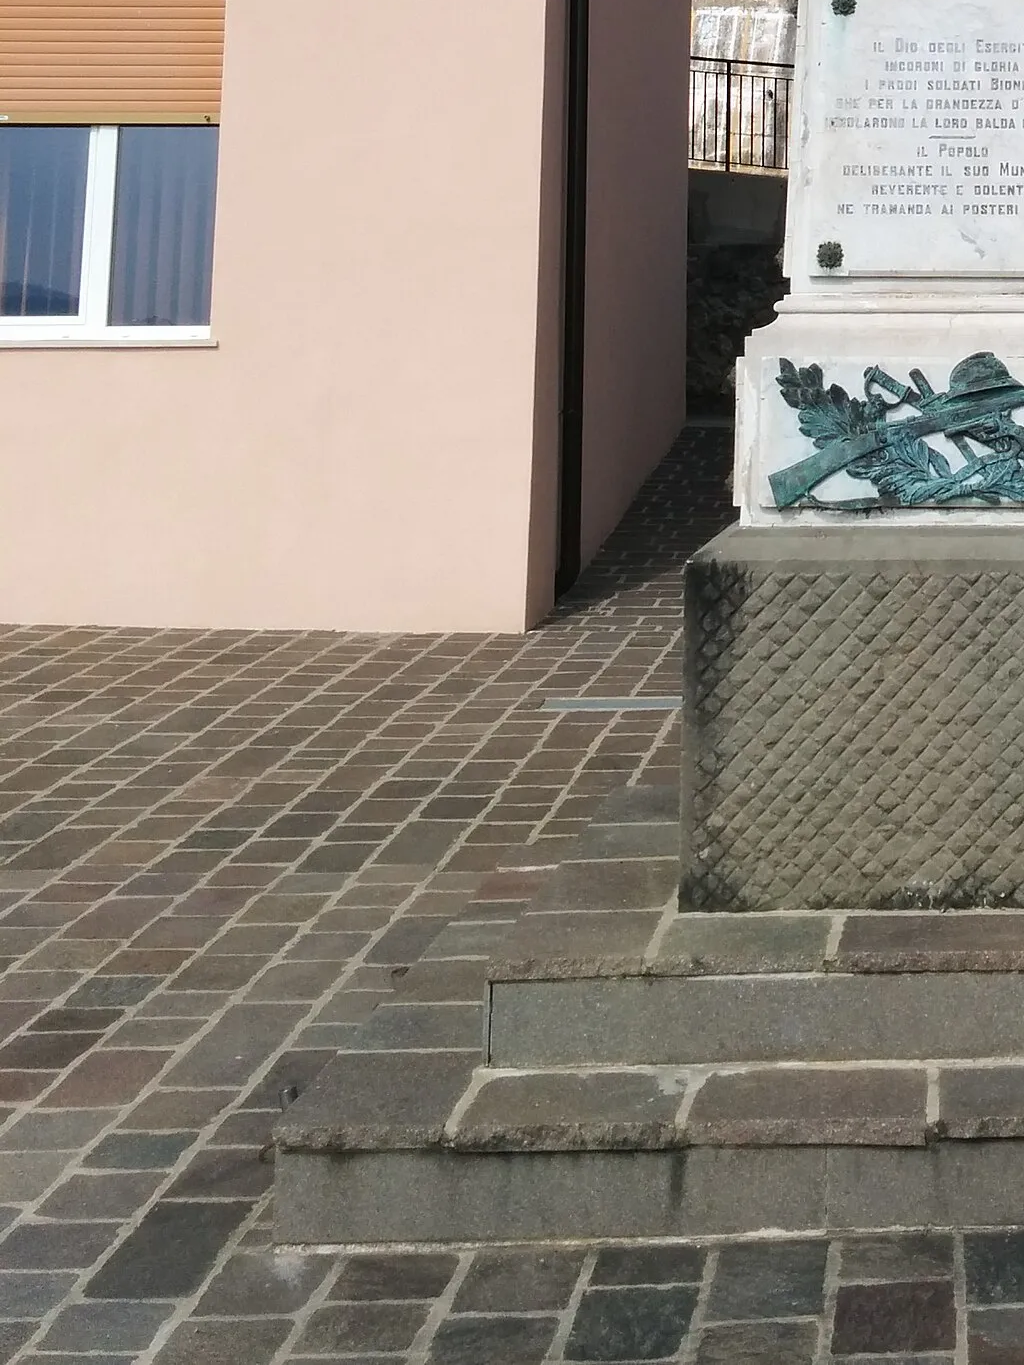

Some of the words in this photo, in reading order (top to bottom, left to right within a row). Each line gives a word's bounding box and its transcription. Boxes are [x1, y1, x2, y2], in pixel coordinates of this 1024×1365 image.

[873, 41, 885, 53] IL
[928, 42, 966, 53] DEGLI
[885, 61, 944, 72] INCORONI
[953, 61, 966, 72] DI
[974, 61, 1020, 72] GLORIA
[864, 79, 869, 91] I
[879, 79, 917, 91] PRODI
[927, 79, 981, 91] SOLDATI
[868, 98, 894, 110] PER
[902, 99, 918, 110] LA
[926, 99, 1003, 110] GRANDEZZA
[912, 117, 928, 129] LA
[935, 118, 968, 129] LORO
[976, 118, 1016, 130] BALDA
[916, 146, 929, 158] IL
[843, 165, 933, 176] DELIBERANTE
[941, 165, 953, 176] IL
[964, 165, 989, 177] SUO
[872, 184, 948, 196] REVERENTE
[956, 185, 964, 196] E
[837, 204, 854, 215] NE
[863, 204, 932, 215] TRAMANDA
[941, 204, 954, 215] AI
[963, 204, 1019, 215] POSTERI
